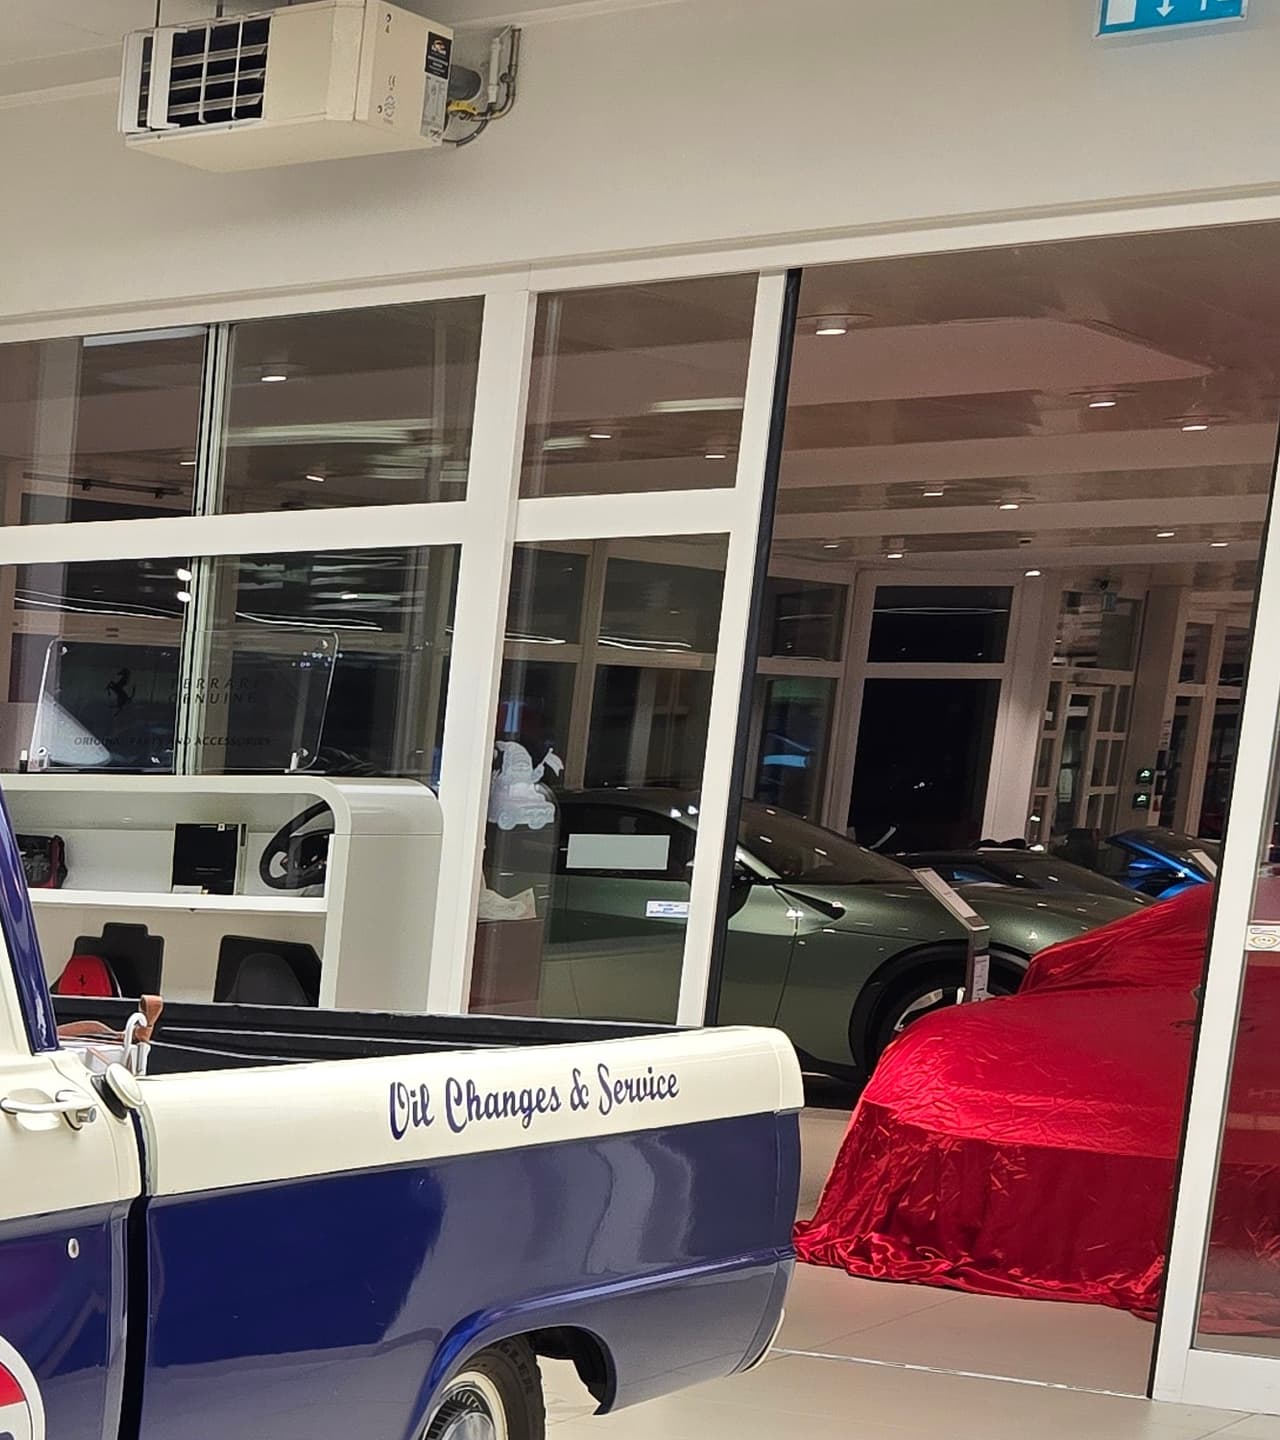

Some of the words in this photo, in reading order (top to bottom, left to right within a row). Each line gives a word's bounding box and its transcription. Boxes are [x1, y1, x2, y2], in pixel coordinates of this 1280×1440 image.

[389, 1081, 435, 1140] Oil
[445, 1077, 562, 1133] Changes
[570, 1068, 590, 1111] &
[596, 1063, 680, 1116] Service
